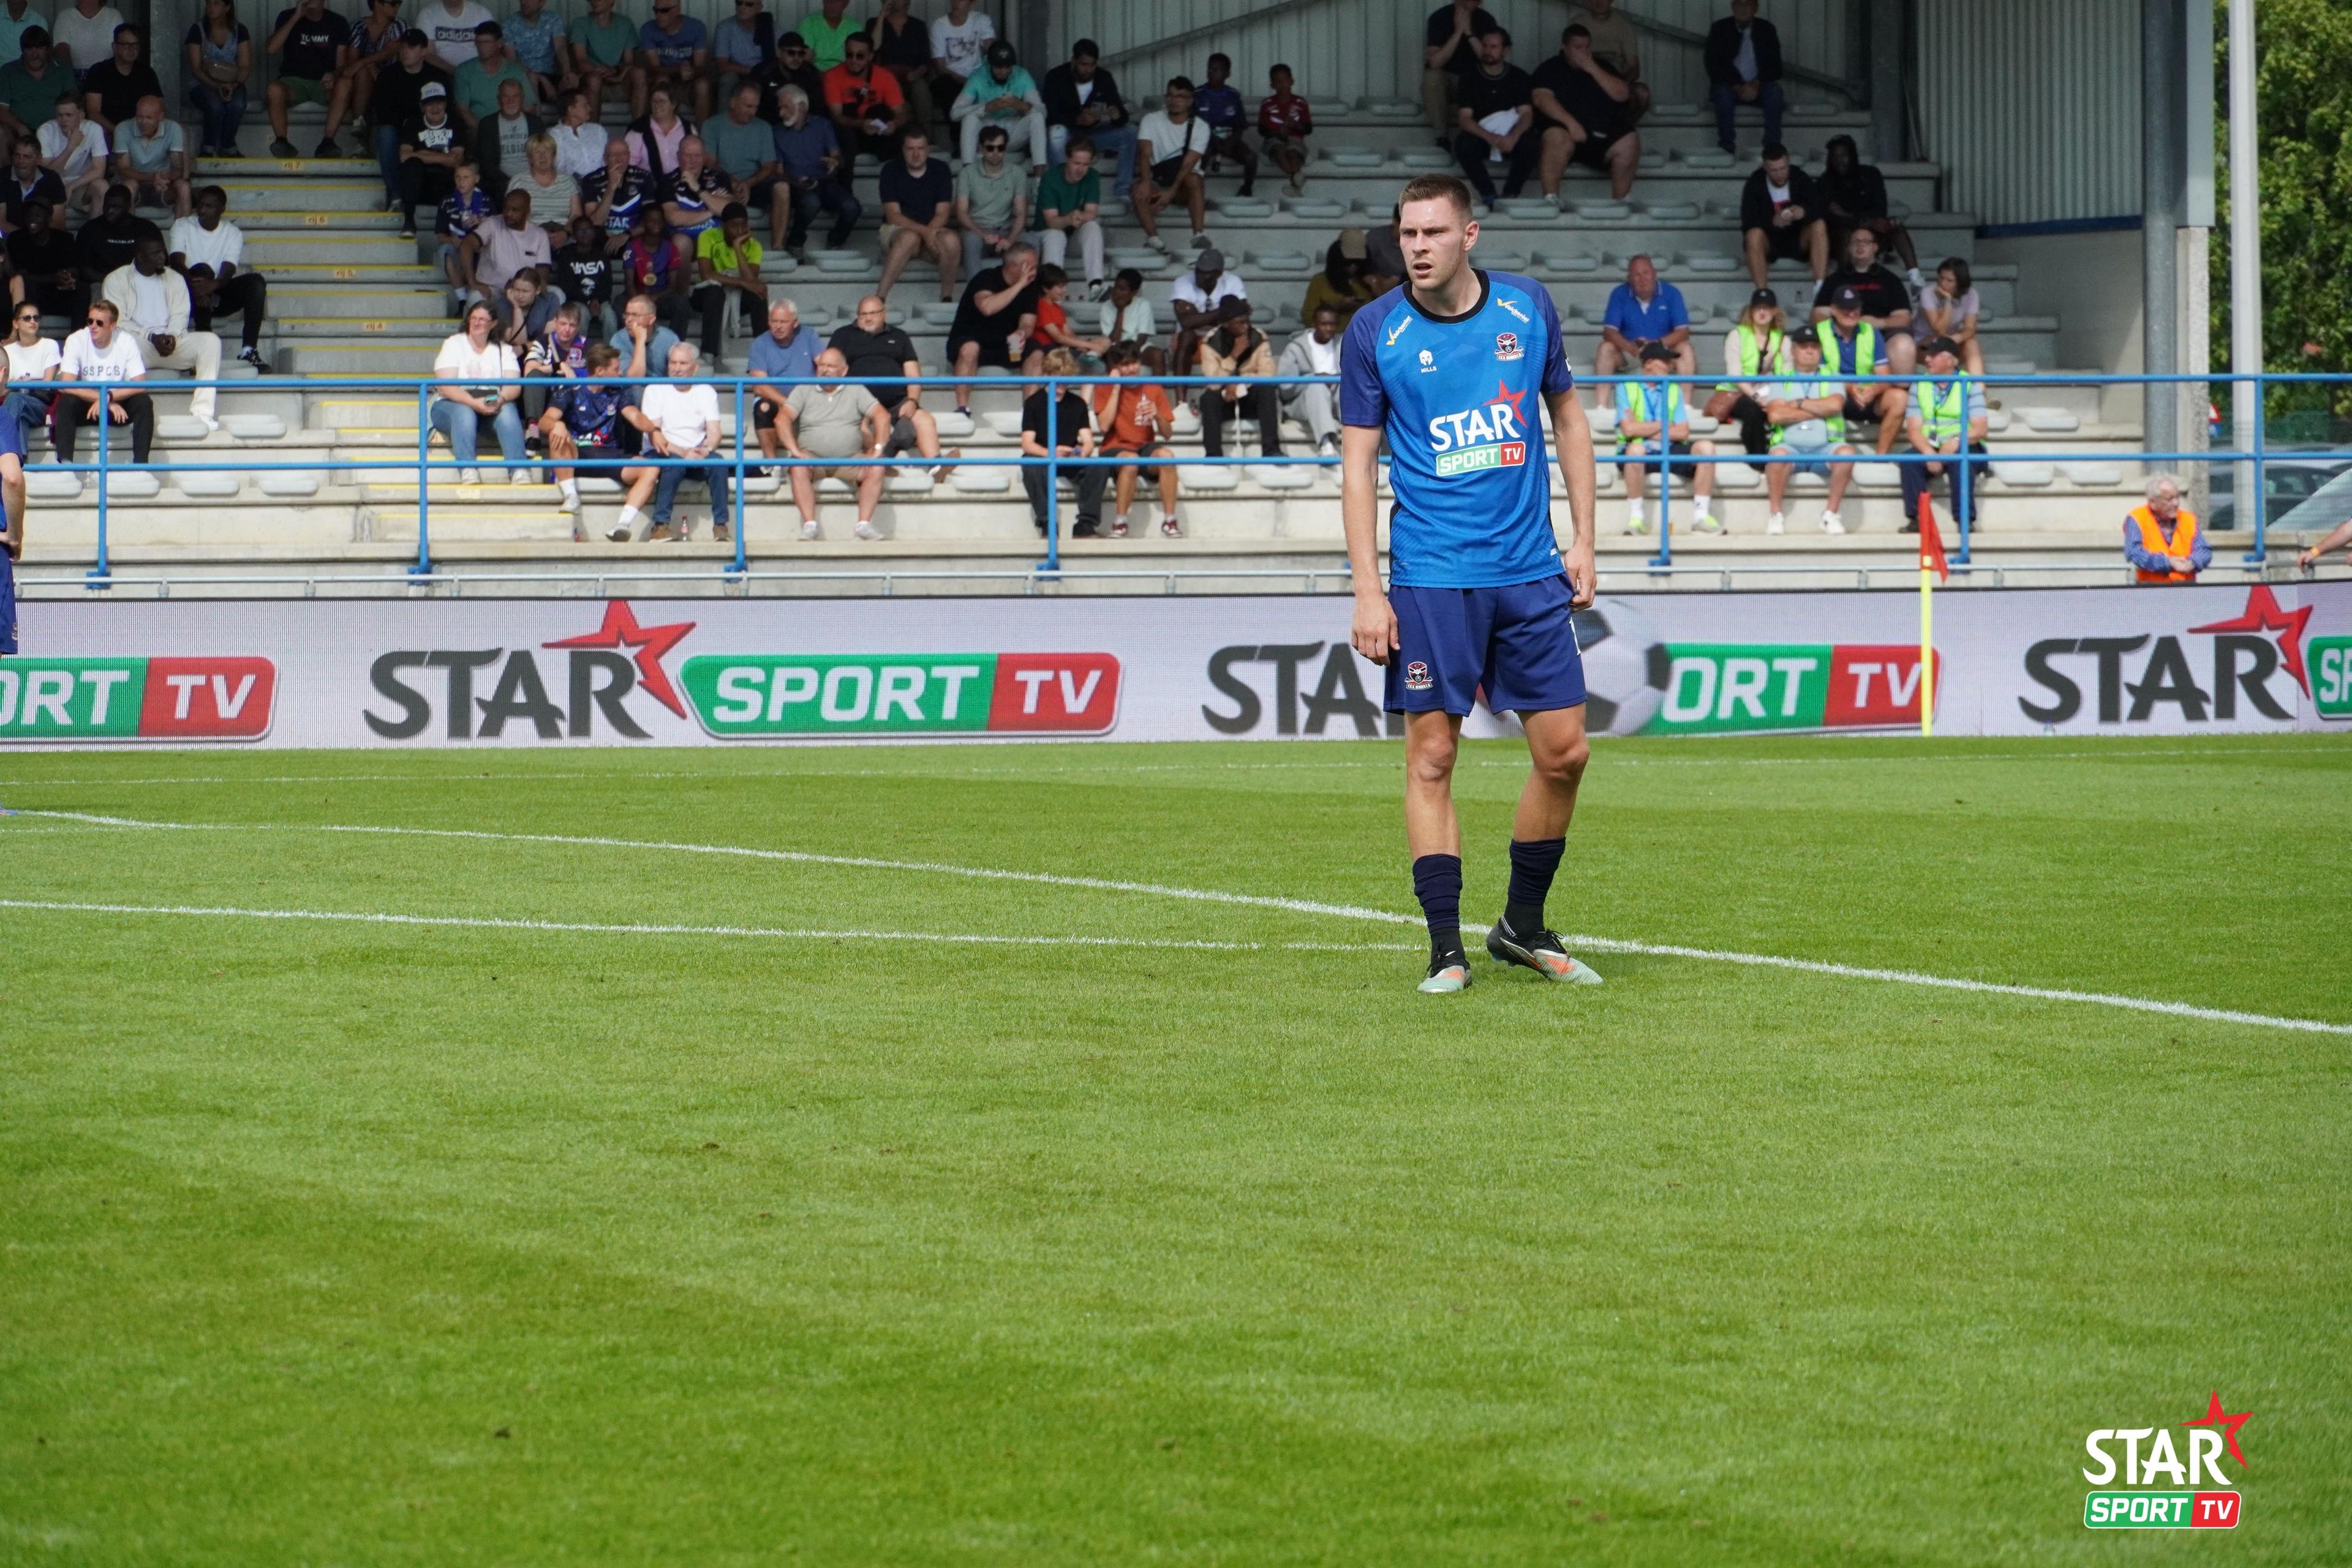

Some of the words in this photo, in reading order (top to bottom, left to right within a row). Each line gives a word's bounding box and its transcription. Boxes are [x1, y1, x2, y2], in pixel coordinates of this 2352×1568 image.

[1430, 404, 1521, 451] STAR
[1440, 448, 1498, 473] SPORT
[1504, 447, 1521, 461] TV
[167, 674, 257, 719] TV
[363, 647, 654, 740] STAR
[713, 665, 980, 722] SPORT
[1015, 669, 1101, 714] TV
[1202, 641, 1406, 736] STA
[1661, 657, 1817, 723] ORT
[1847, 662, 1922, 707] TV
[2018, 633, 2296, 724] STAR
